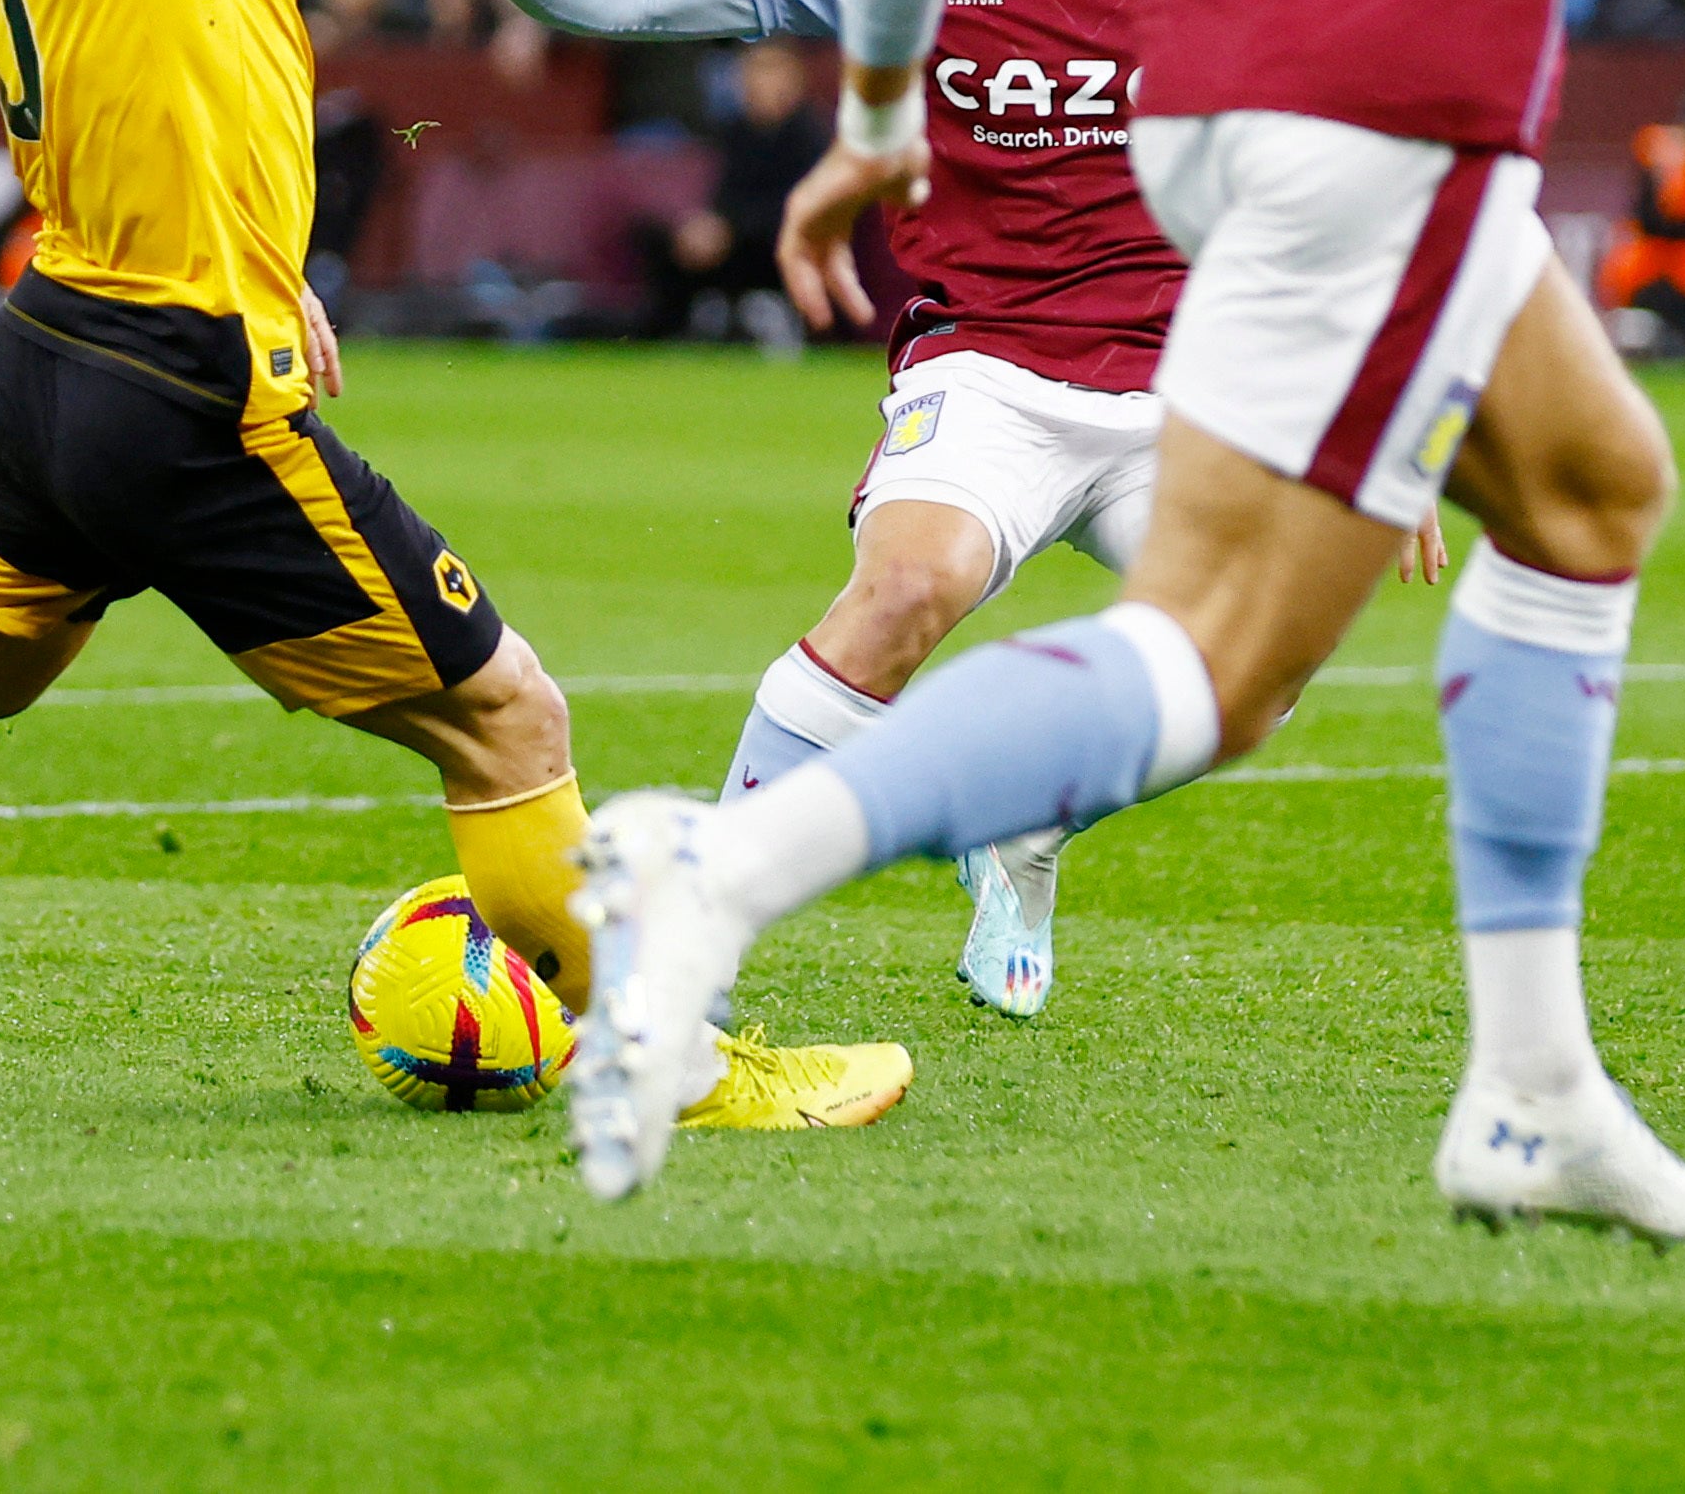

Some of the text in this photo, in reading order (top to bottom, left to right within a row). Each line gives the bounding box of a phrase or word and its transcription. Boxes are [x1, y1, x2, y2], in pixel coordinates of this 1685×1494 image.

[935, 58, 1145, 117] CAZ
[973, 125, 1134, 148] Search. Drive.
[897, 395, 941, 419] AVFC
